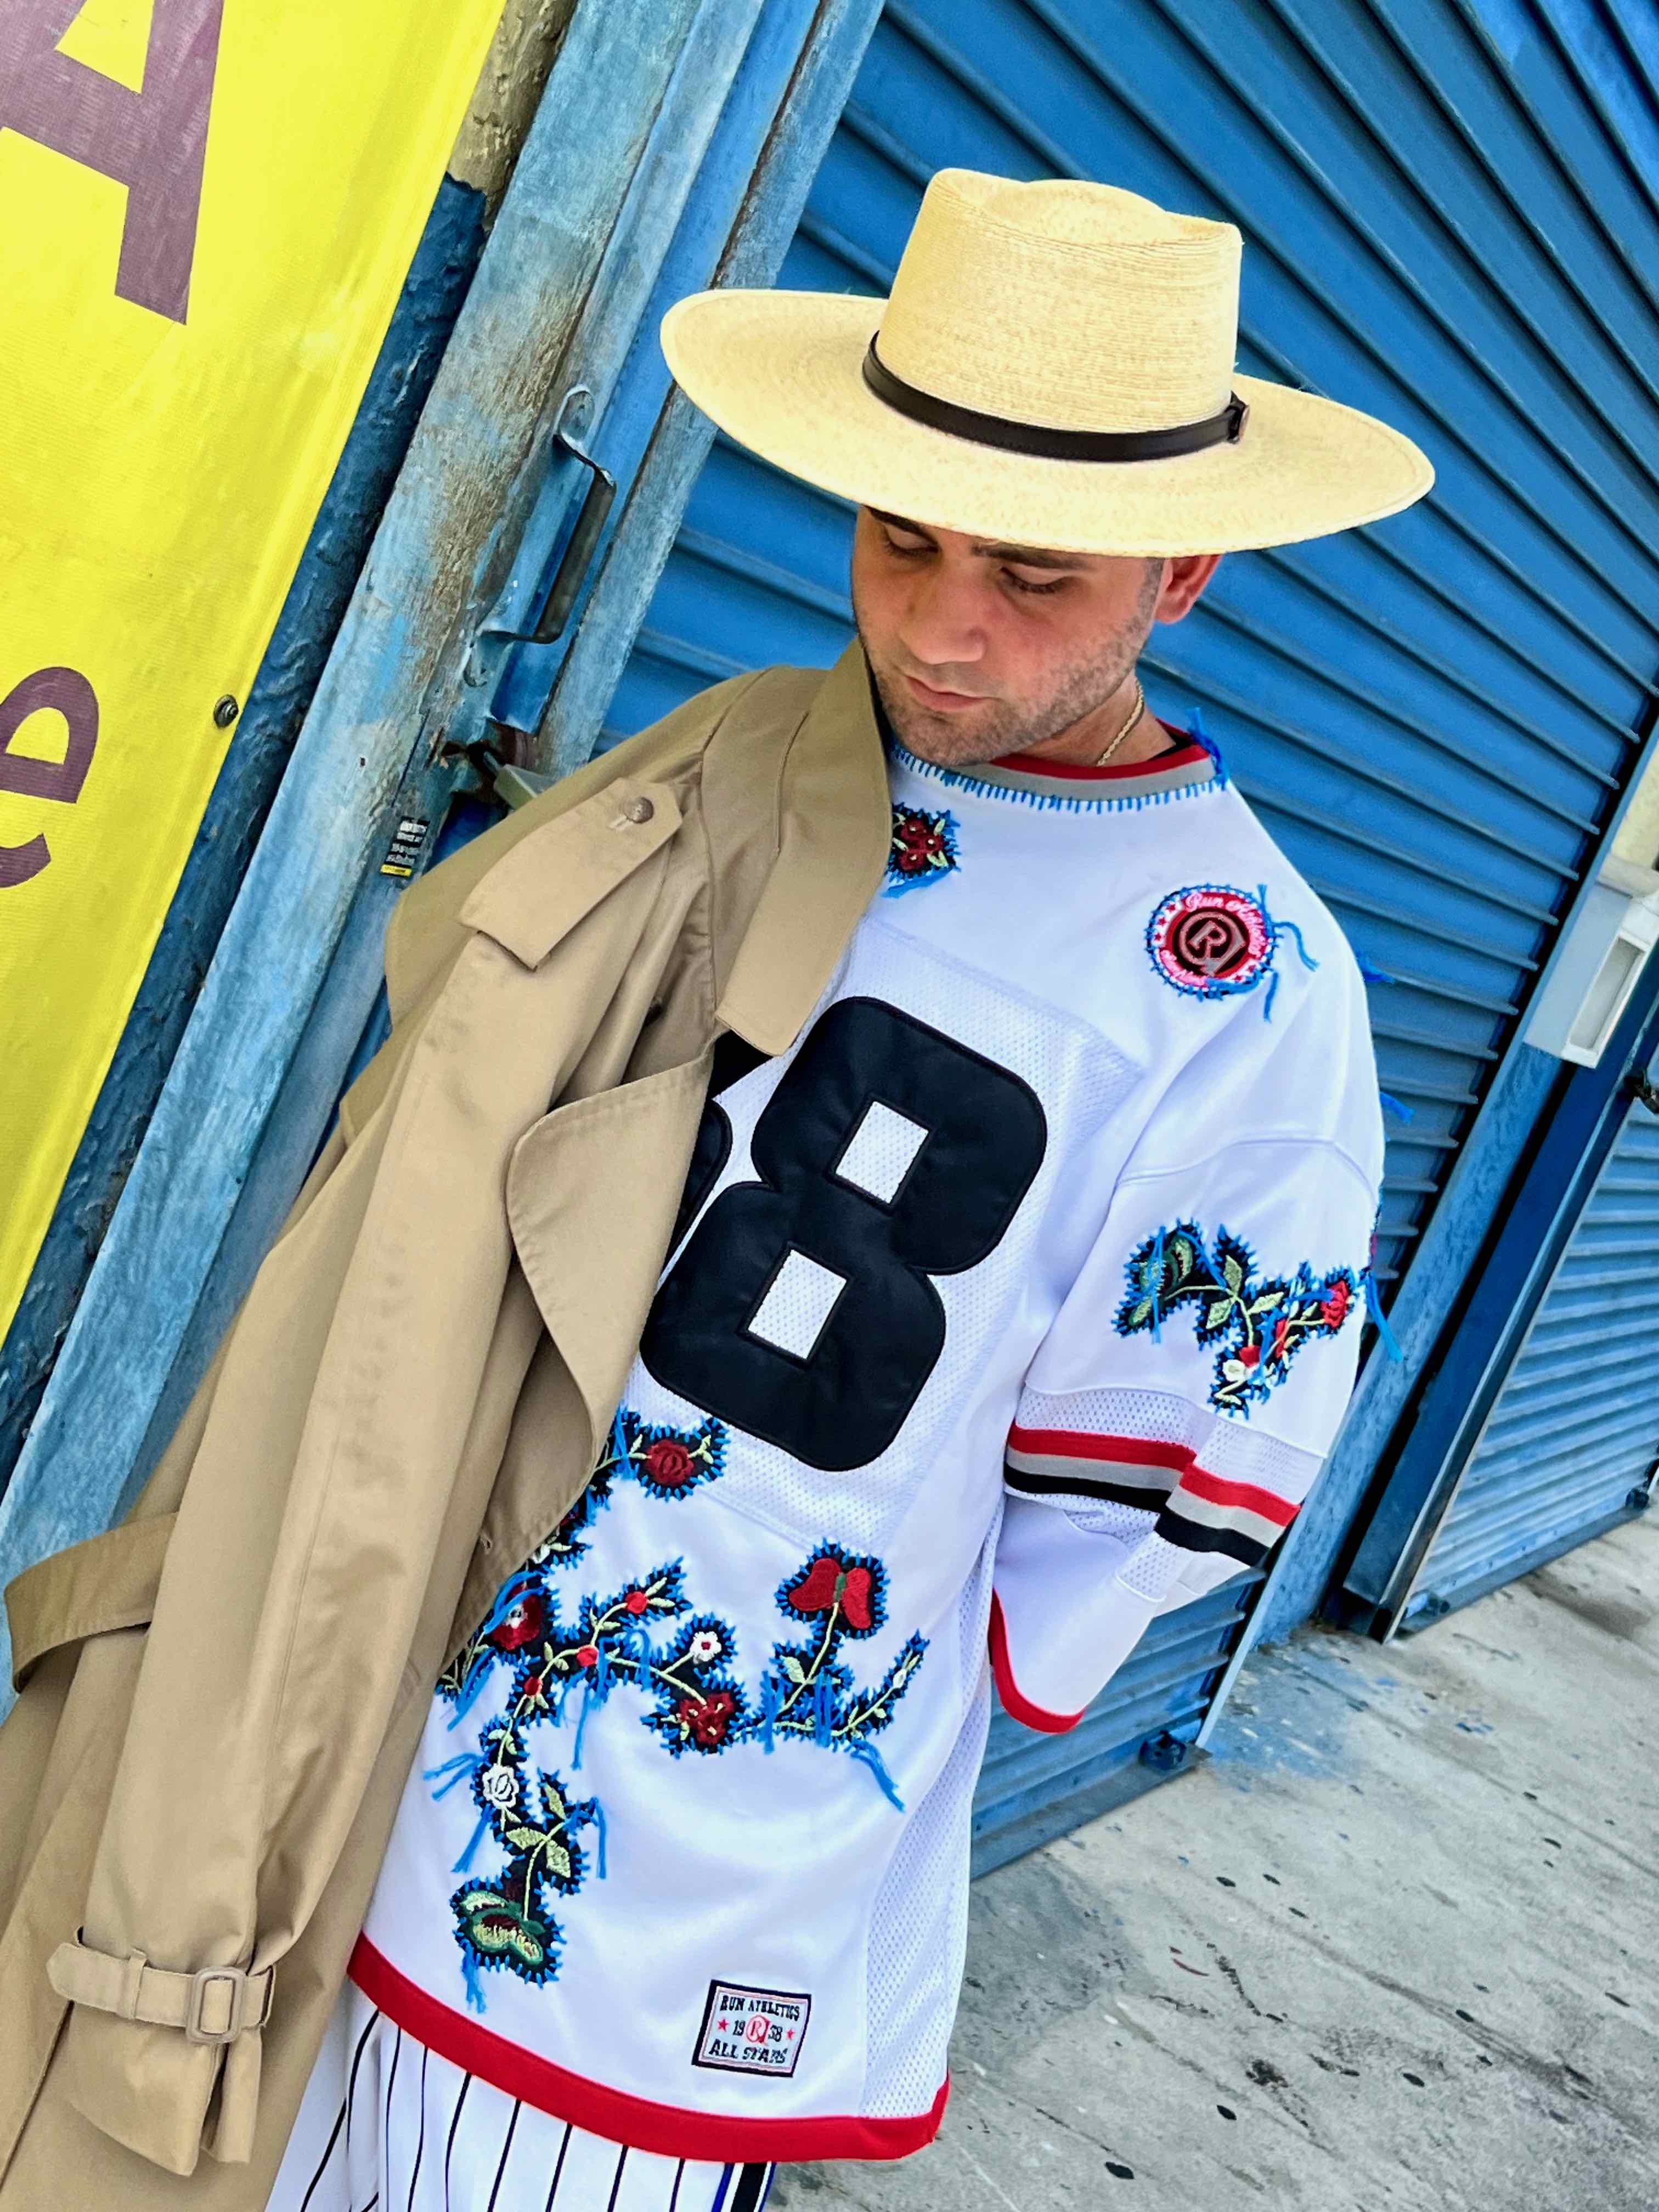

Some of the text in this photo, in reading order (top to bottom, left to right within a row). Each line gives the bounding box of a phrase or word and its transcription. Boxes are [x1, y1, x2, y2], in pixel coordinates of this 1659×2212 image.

[0, 667, 99, 889] e
[1184, 893, 1224, 913] Run
[639, 996, 1048, 1471] 8
[720, 1995, 800, 2021] RUN ATHLETICS
[732, 2019, 746, 2036] 19
[708, 2039, 788, 2063] ALL STARS
